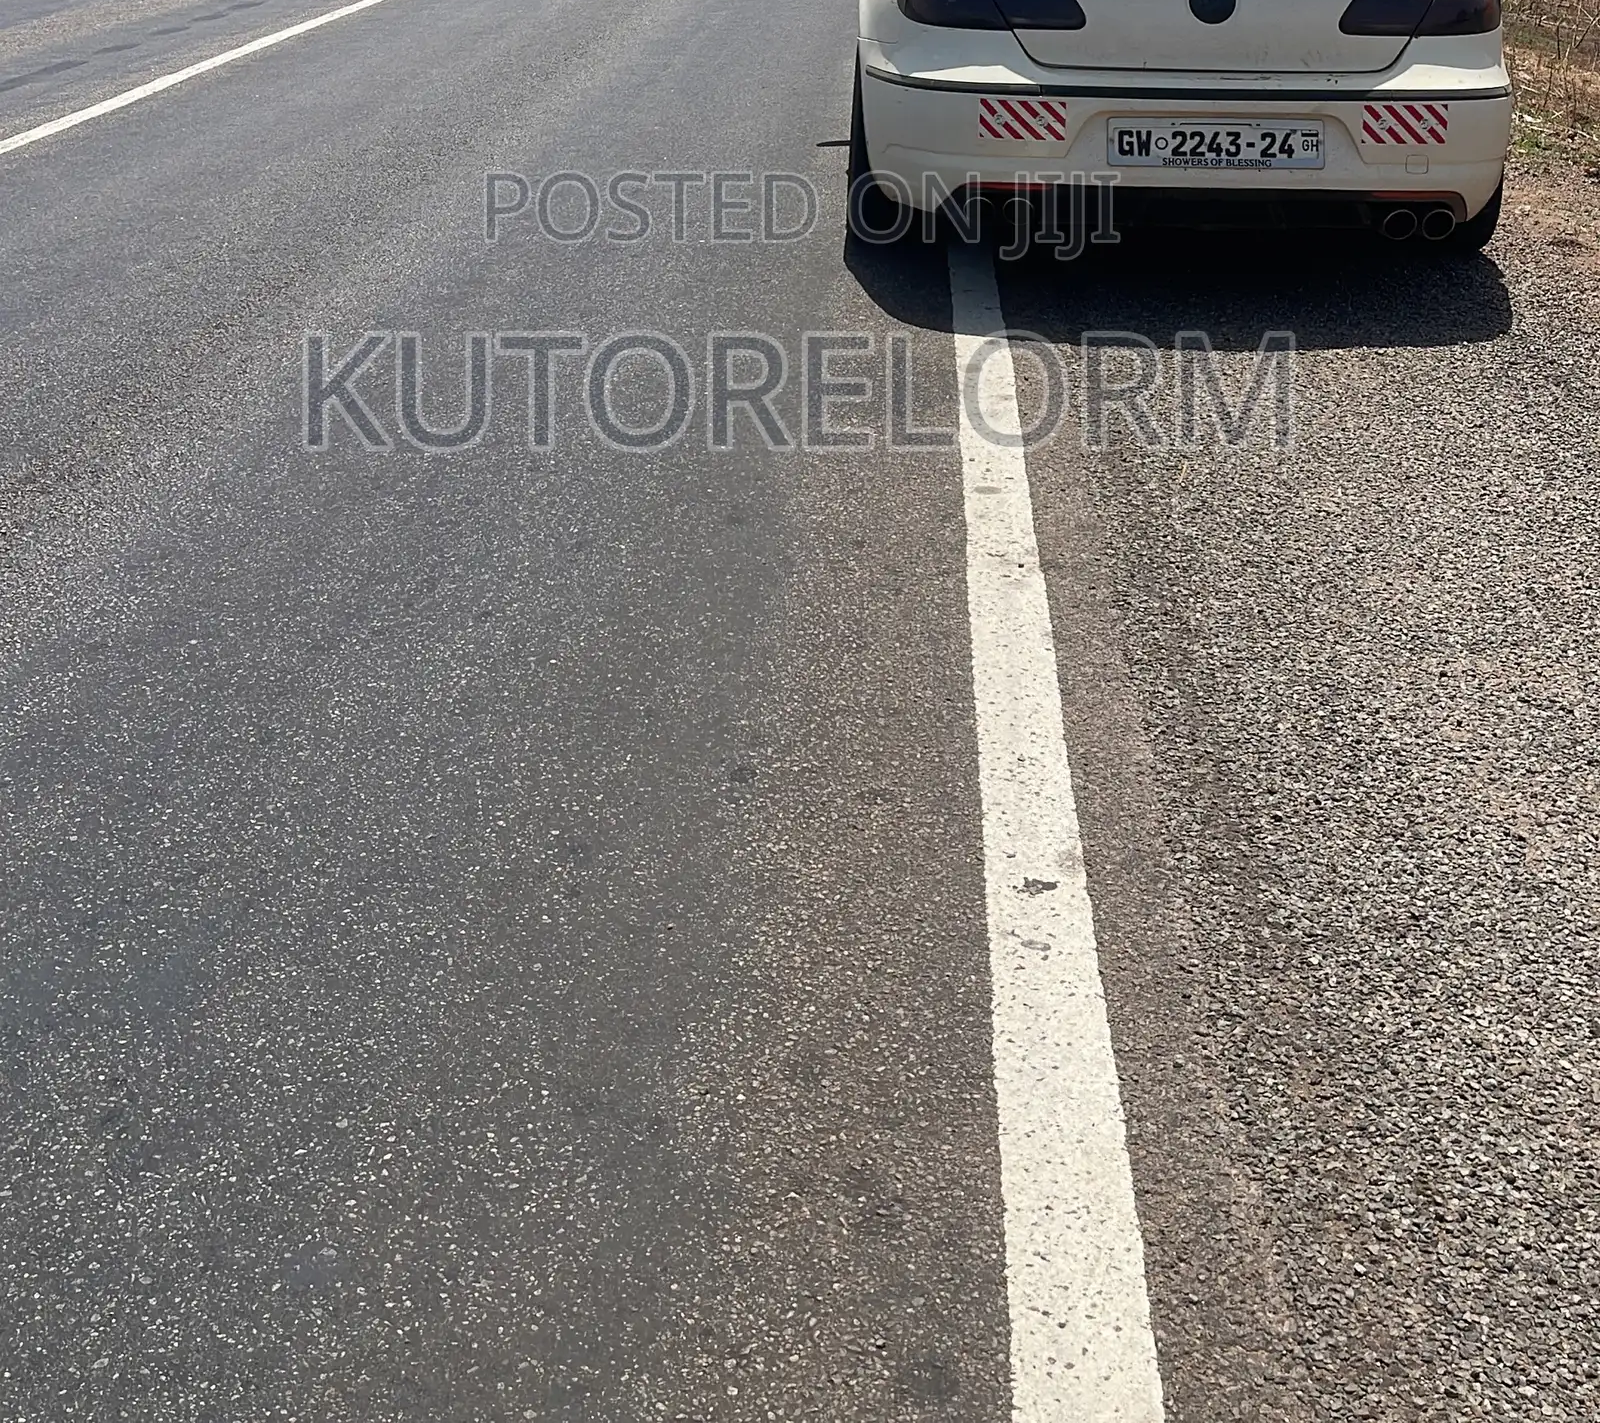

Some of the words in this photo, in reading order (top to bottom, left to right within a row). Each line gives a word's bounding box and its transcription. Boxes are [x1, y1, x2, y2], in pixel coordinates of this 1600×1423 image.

[1118, 130, 1151, 157] GW
[1171, 131, 1295, 158] 2243-24
[1302, 140, 1319, 152] GH
[1162, 157, 1208, 166] SHOWERS
[1211, 158, 1223, 166] OF
[1226, 159, 1272, 167] BLESSING
